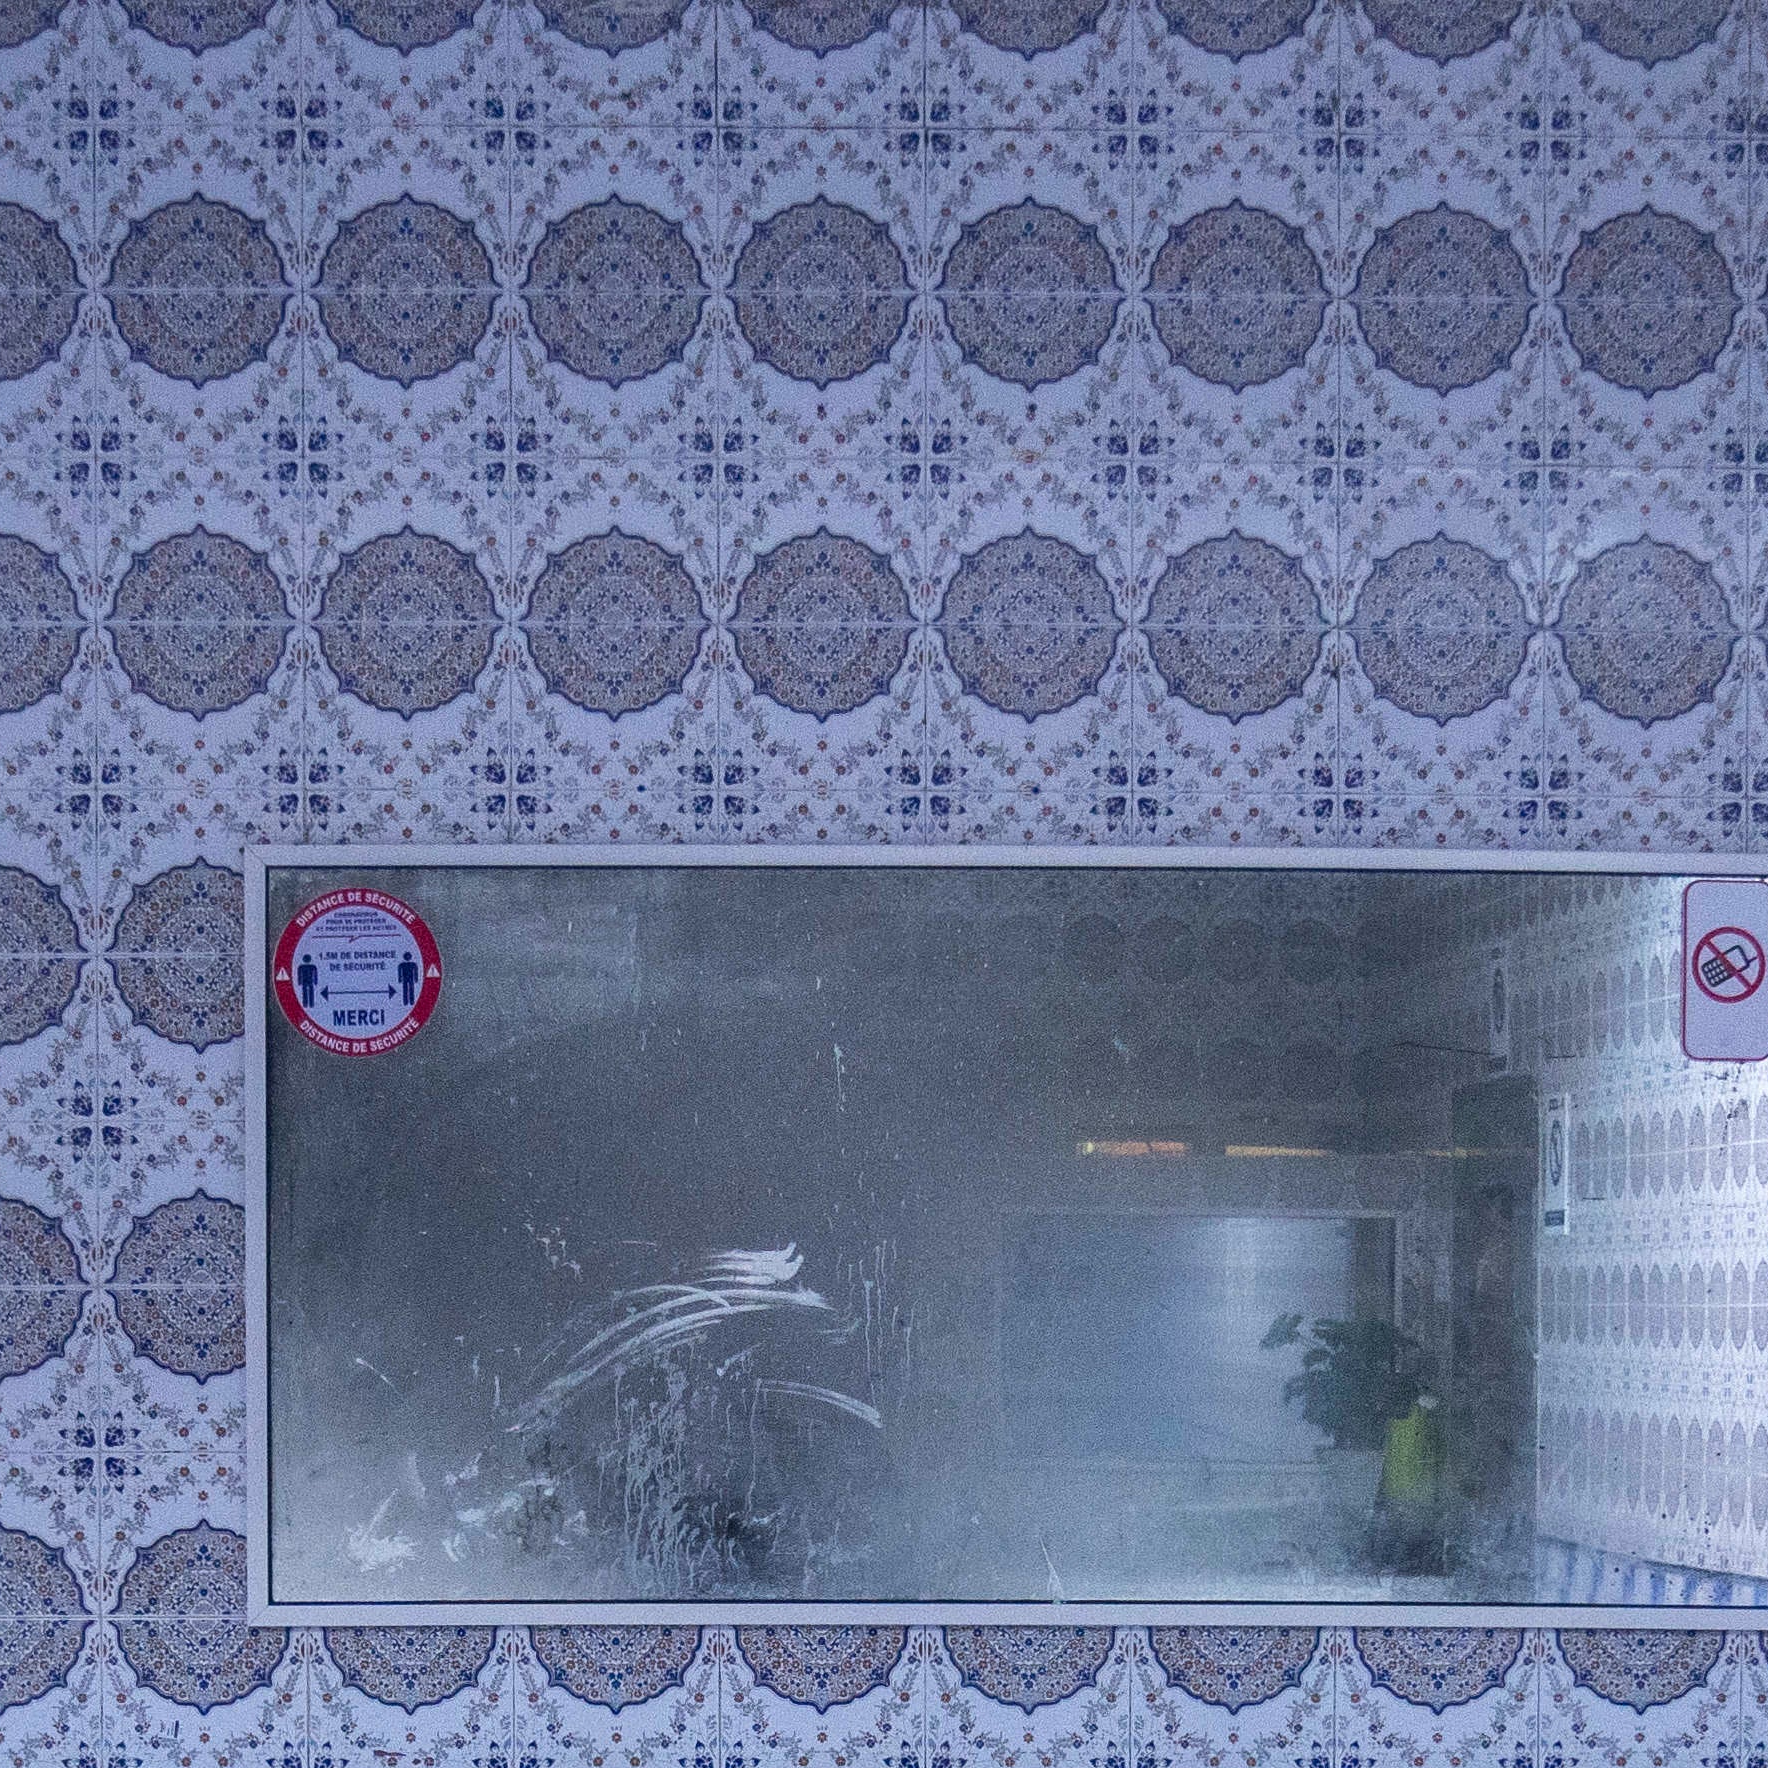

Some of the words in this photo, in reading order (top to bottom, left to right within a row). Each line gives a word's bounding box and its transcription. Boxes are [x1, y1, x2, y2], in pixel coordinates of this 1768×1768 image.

[296, 893, 345, 927] DISTANCE
[347, 892, 362, 902] DE
[340, 951, 351, 960] DE
[354, 950, 396, 959] DISTANCE
[329, 962, 341, 971] DE
[332, 1009, 385, 1026] MERCI
[300, 1020, 350, 1052] DISTANCE
[352, 1042, 368, 1053] DE
